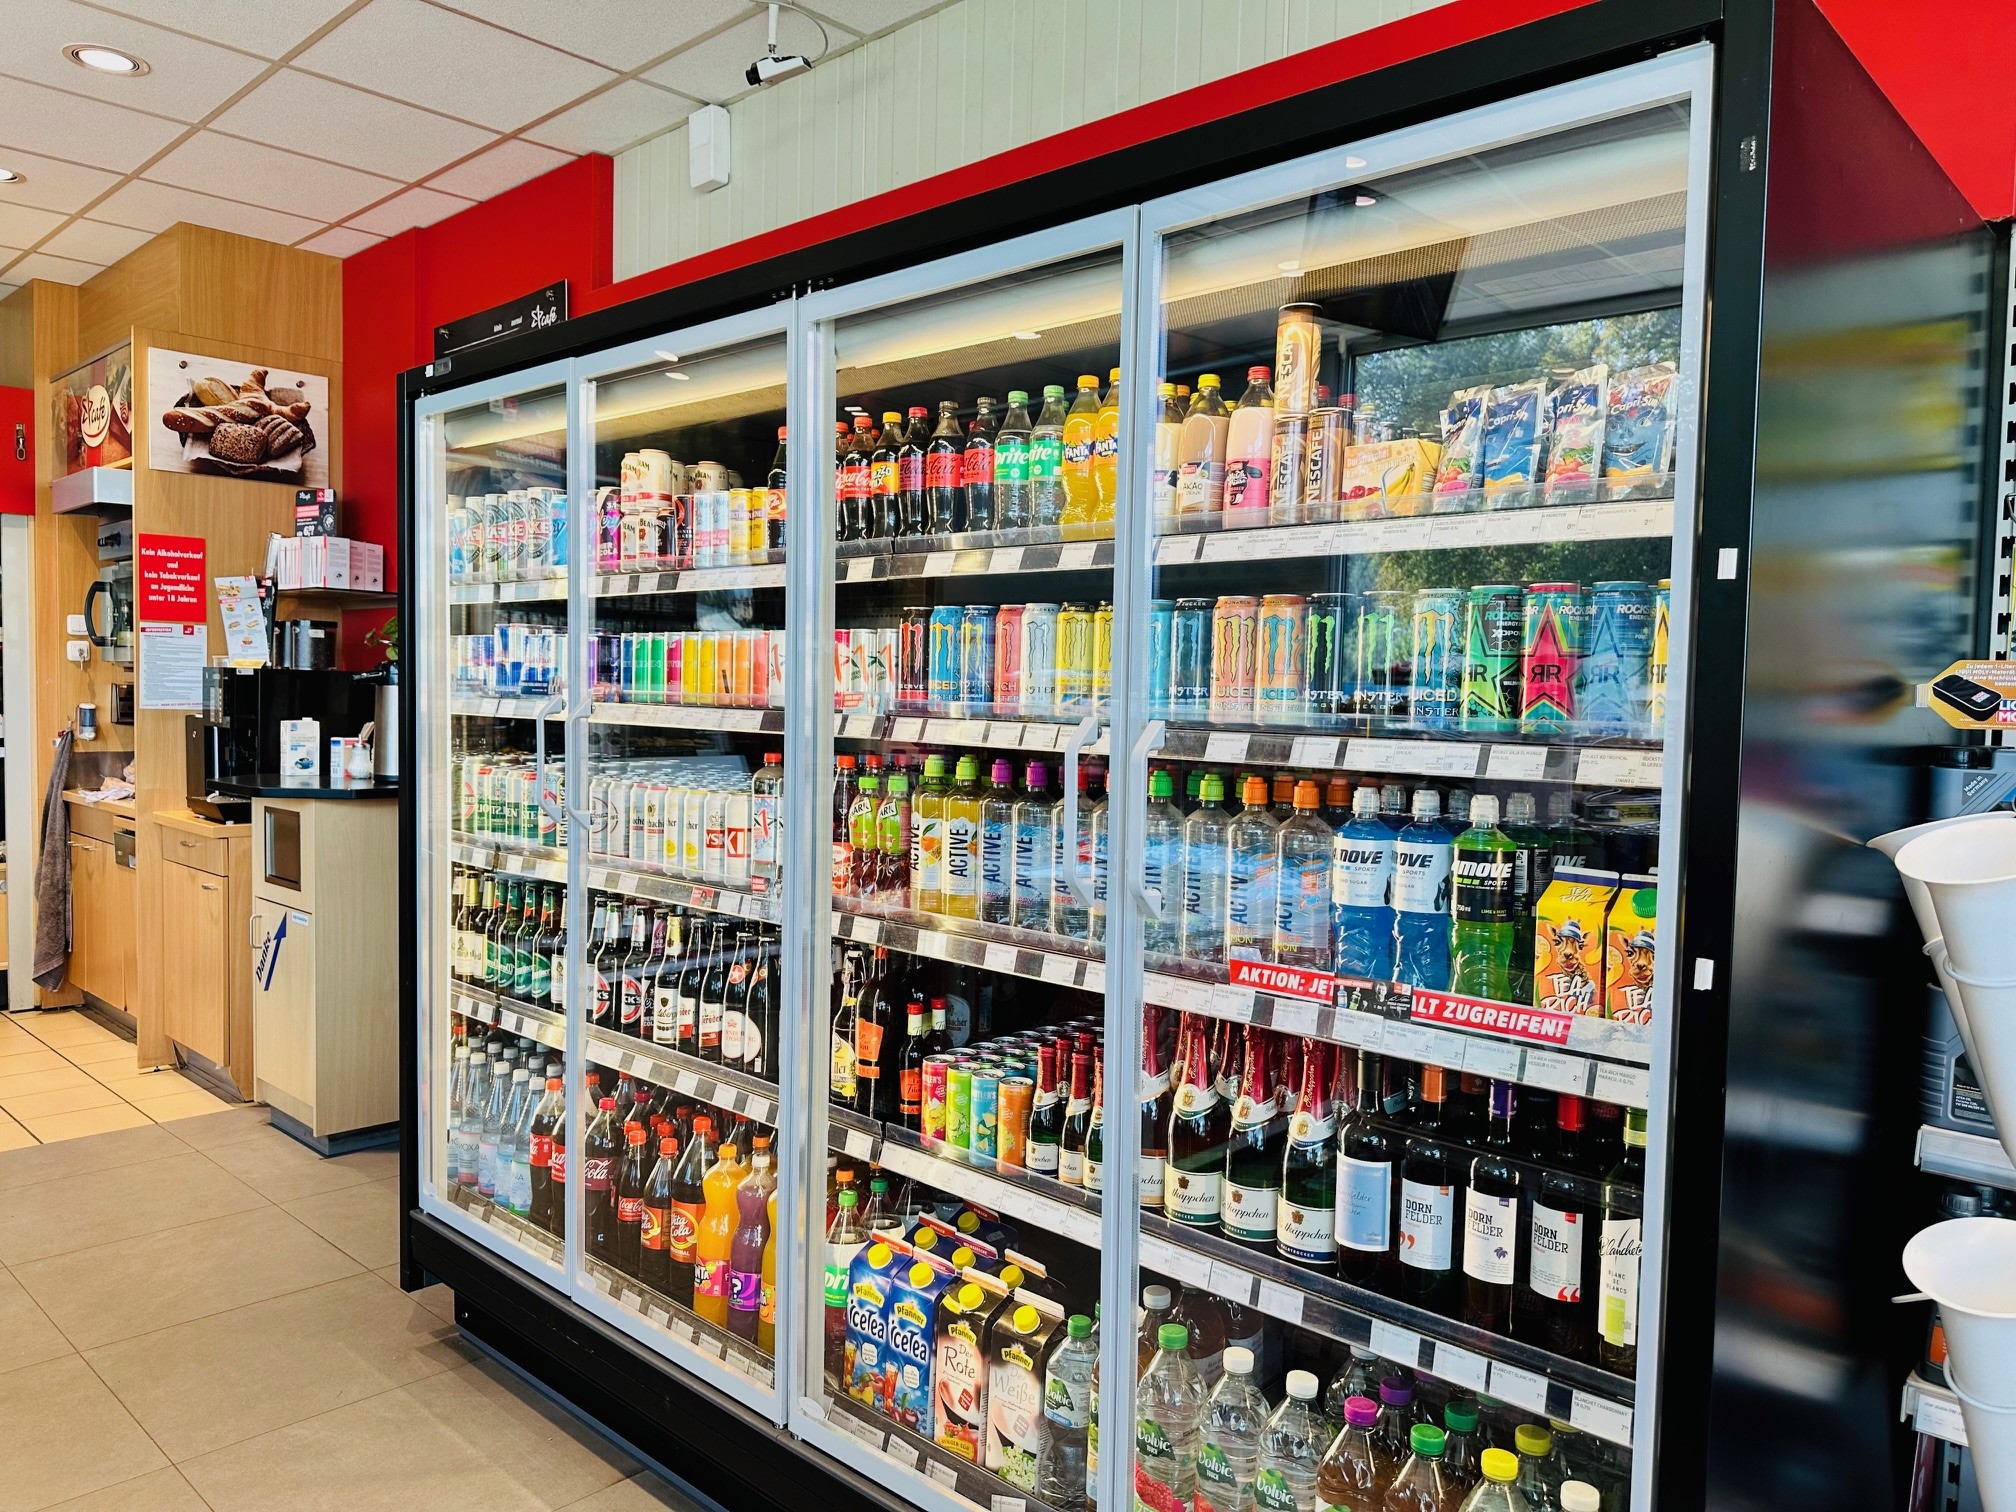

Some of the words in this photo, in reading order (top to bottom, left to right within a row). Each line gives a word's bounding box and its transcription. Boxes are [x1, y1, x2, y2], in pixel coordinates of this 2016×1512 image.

[1065, 445, 1090, 459] FANTA
[141, 547, 156, 556] Kein
[156, 548, 203, 559] Alkoholverkauf
[166, 560, 179, 569] und
[144, 570, 158, 579] kein
[159, 571, 201, 581] Tabakverkauf
[160, 582, 195, 593] Jugendliche
[148, 594, 165, 602] unter
[167, 593, 176, 602] 18
[176, 594, 198, 603] Jahren
[1558, 605, 1599, 615] ROCKSTAR
[1963, 780, 1978, 792] Made
[1966, 777, 1989, 797] Germany
[949, 828, 969, 878] ACTIVE
[982, 831, 1001, 884] ACTIVE
[1354, 865, 1378, 873] SPORTS
[255, 931, 272, 984] Danke
[1238, 966, 1306, 990] AKTION:
[1442, 1000, 1564, 1039] ZUGREIFEN!
[1405, 1198, 1433, 1215] DORN
[1405, 1209, 1443, 1226] FELDER
[1468, 1207, 1493, 1225] DORN
[1467, 1219, 1504, 1238] FELDER
[1533, 1221, 1558, 1241] DORN
[1533, 1232, 1569, 1254] FELDER
[1599, 1236, 1642, 1256] Blanchet
[1608, 1270, 1626, 1280] BLANC
[1612, 1278, 1620, 1286] DE
[855, 1285, 882, 1304] pfanner
[1606, 1283, 1628, 1295] BLANCS
[896, 1304, 925, 1325] pfanner
[950, 1326, 975, 1343] pfanner
[959, 1344, 973, 1358] Der
[1003, 1350, 1032, 1367] pfanner
[944, 1345, 976, 1379] Rote
[1010, 1367, 1026, 1381] Der
[994, 1368, 1035, 1406] Weiße
